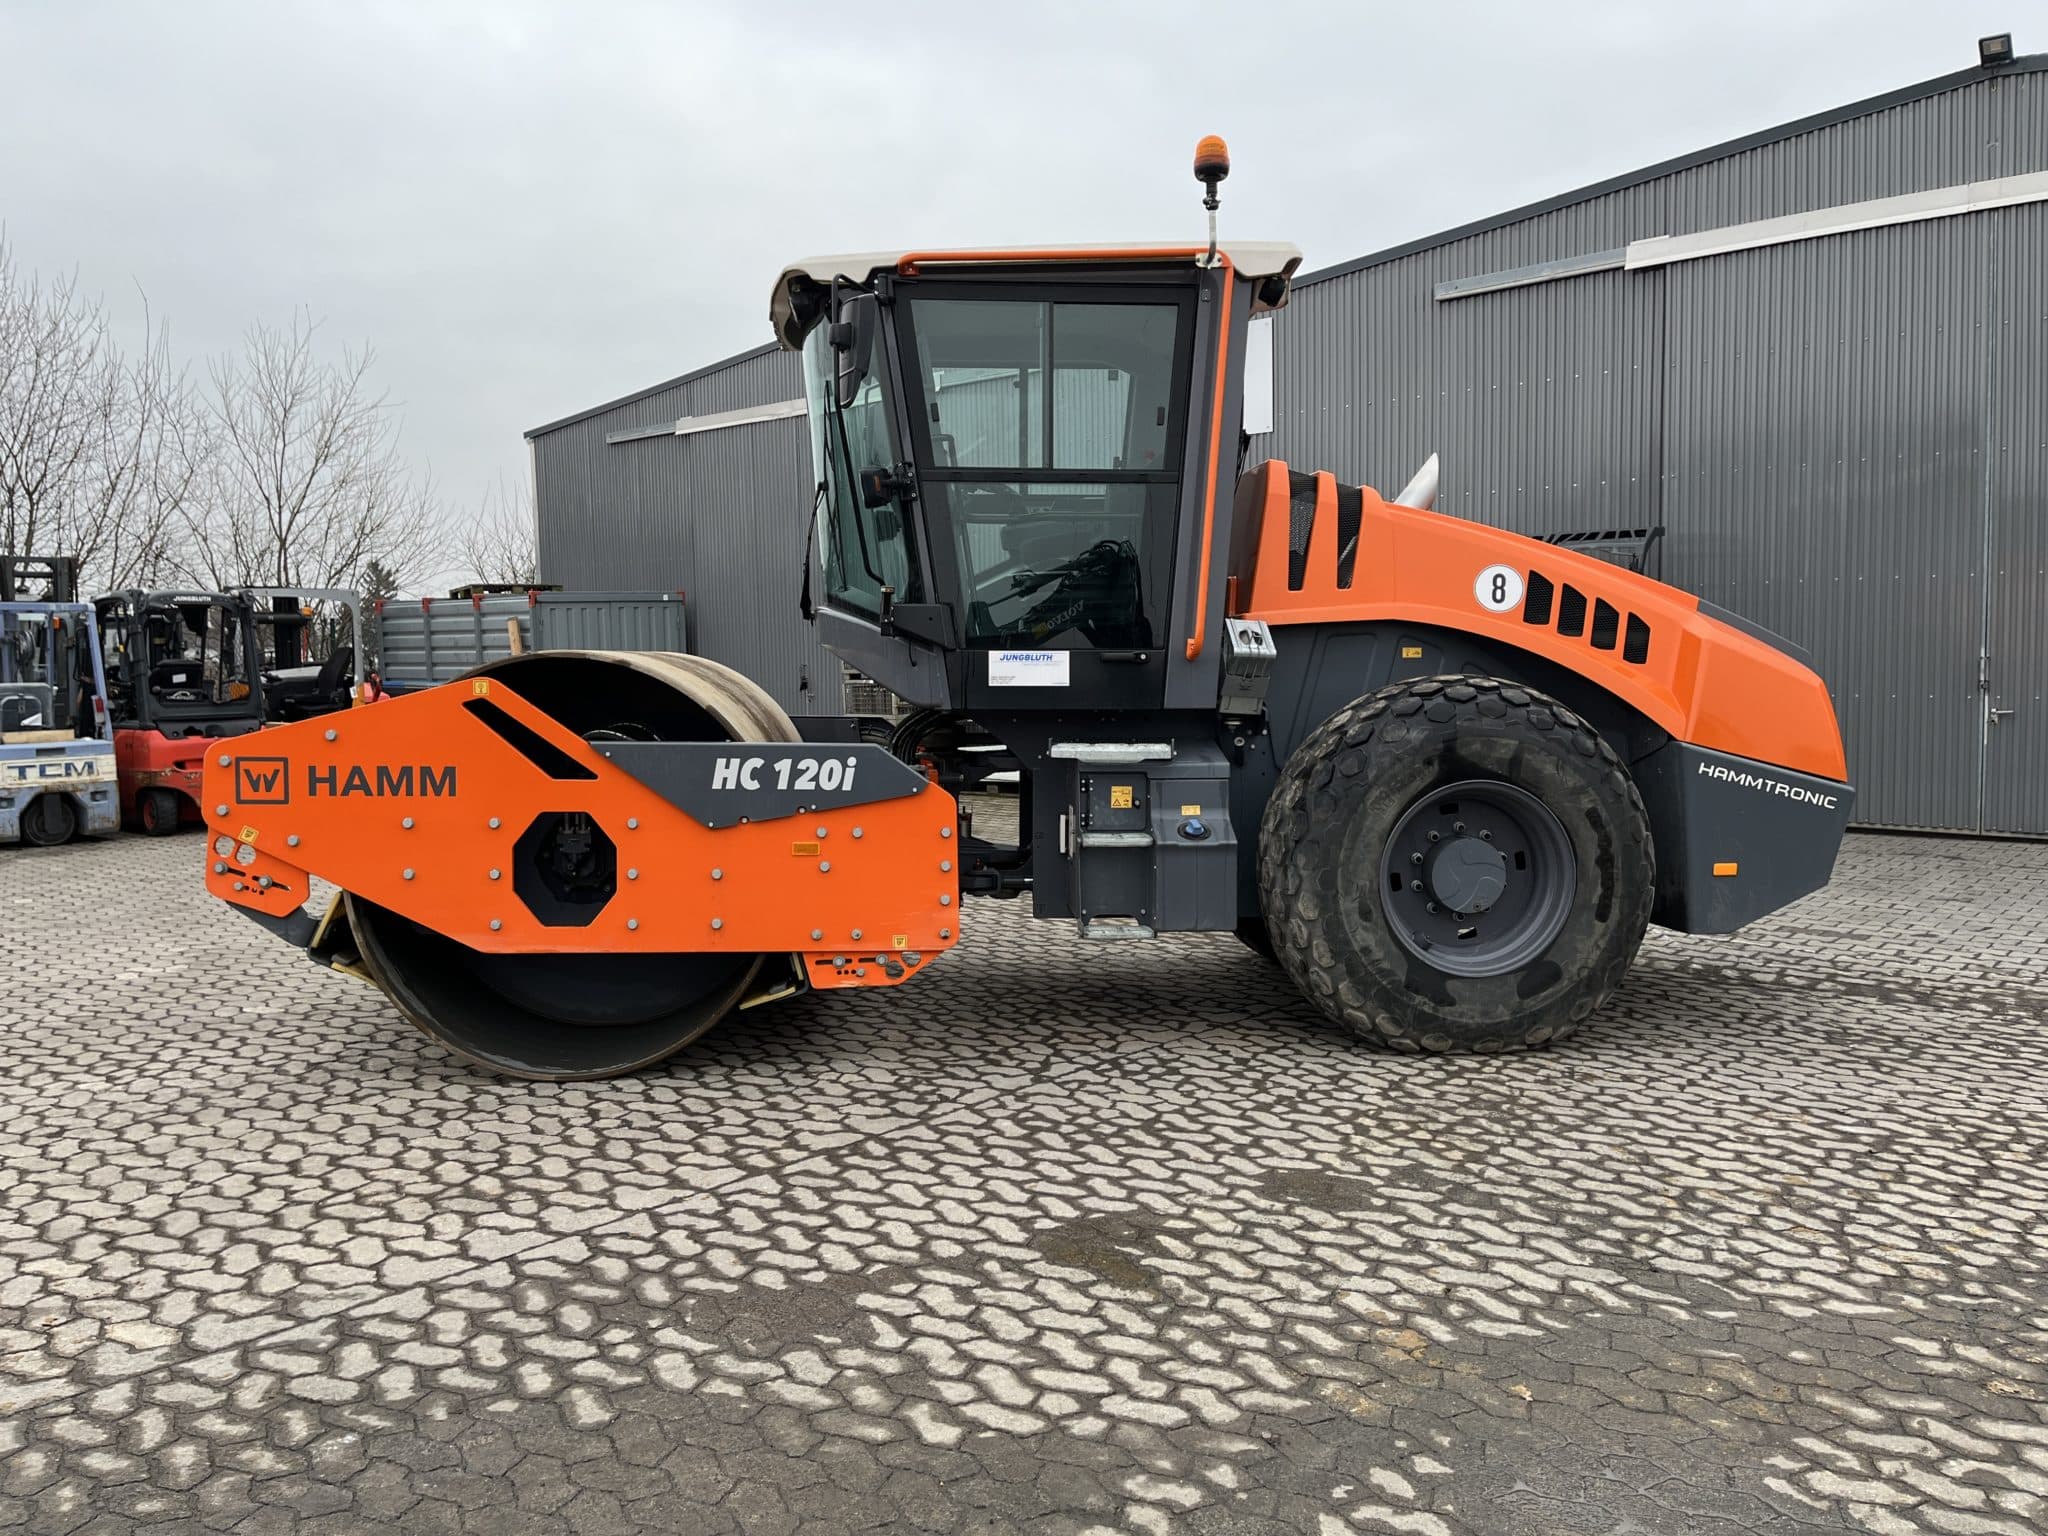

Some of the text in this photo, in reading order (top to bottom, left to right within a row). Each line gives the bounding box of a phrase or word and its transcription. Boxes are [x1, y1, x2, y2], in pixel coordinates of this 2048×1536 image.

[1492, 573, 1506, 604] 8
[1000, 654, 1053, 662] JUNGBLUTH
[7, 761, 95, 780] TCM
[307, 765, 456, 796] HAMM
[711, 756, 857, 791] HC 120i
[1698, 762, 1838, 809] HAMMTRONIC
